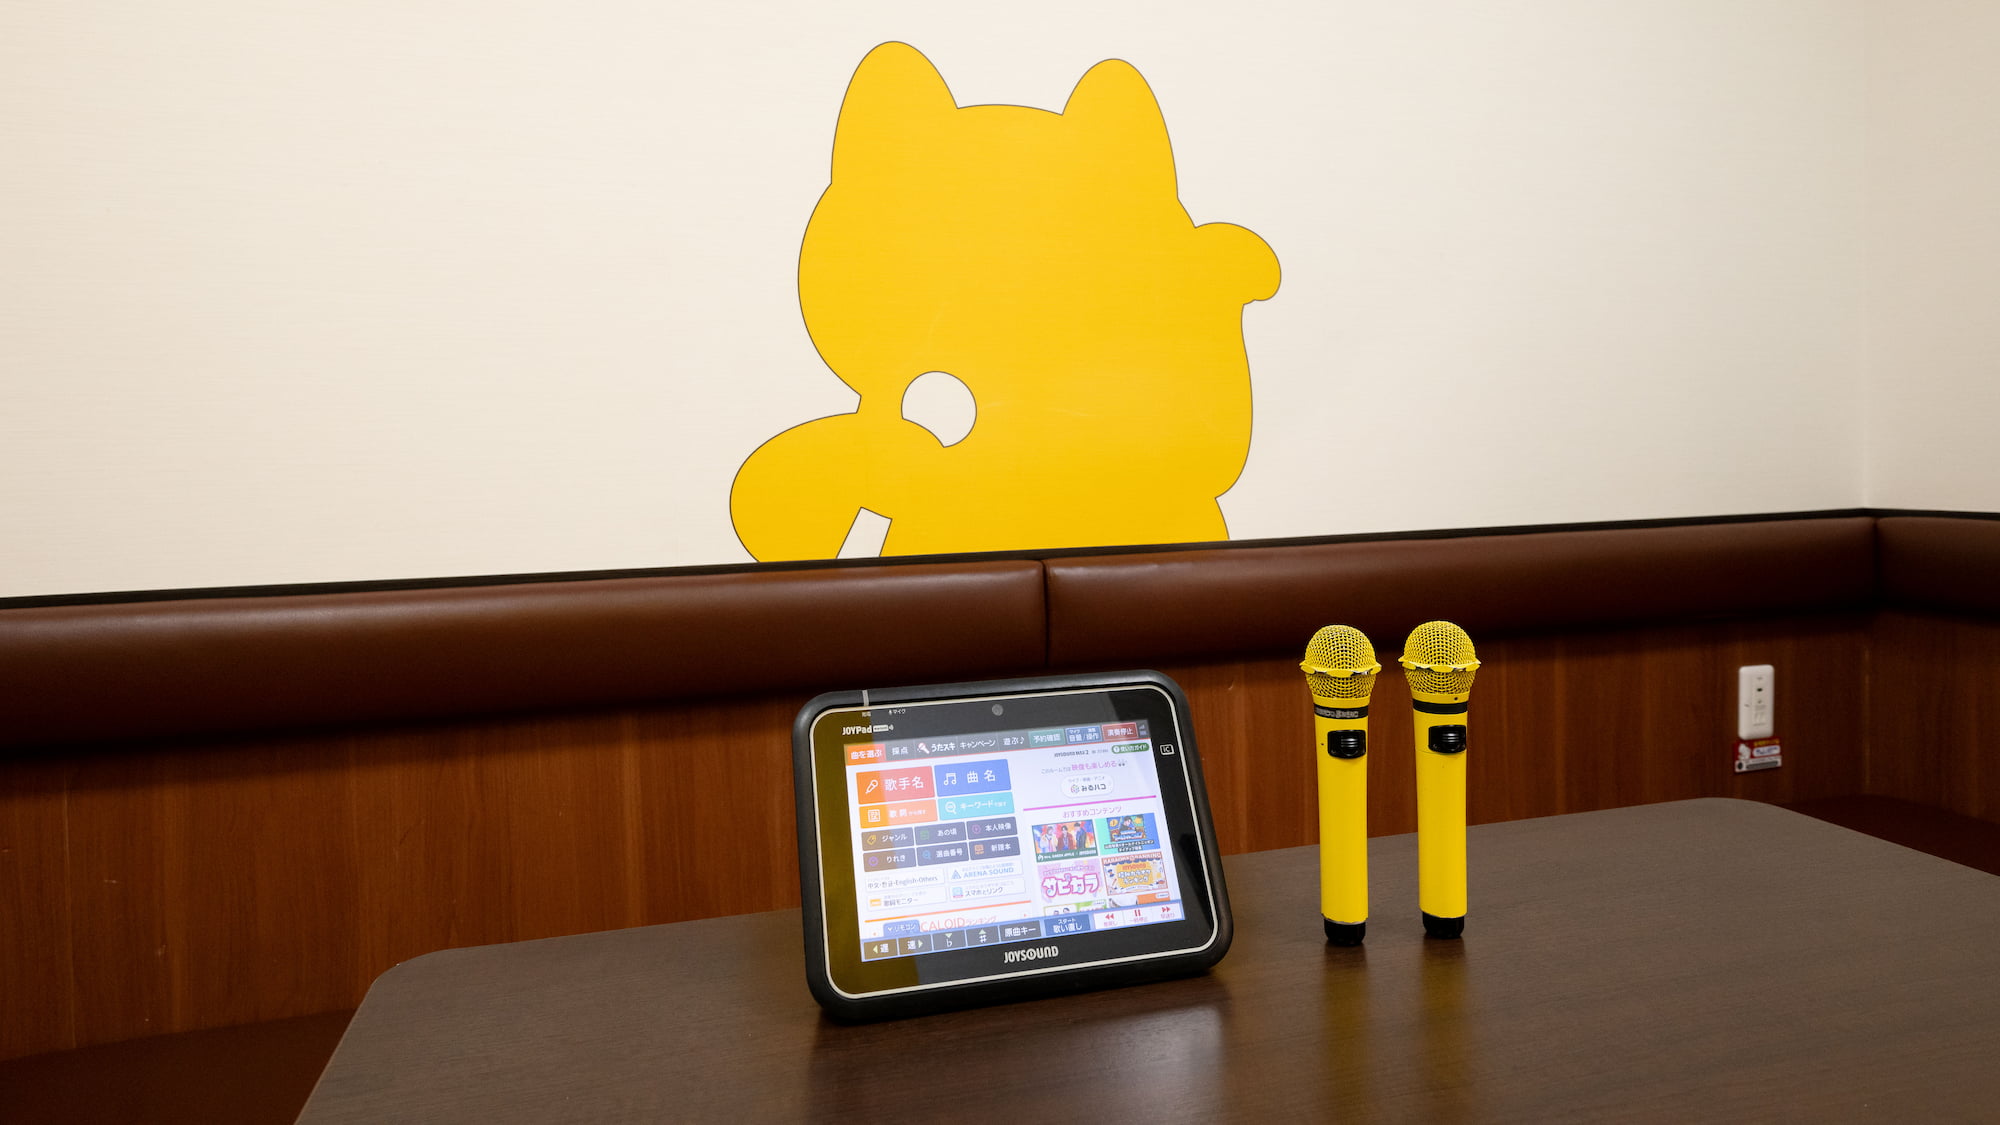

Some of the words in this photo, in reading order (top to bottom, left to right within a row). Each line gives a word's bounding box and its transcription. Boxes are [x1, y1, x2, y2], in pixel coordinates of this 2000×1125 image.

[842, 725, 872, 735] JOYPad
[1107, 728, 1134, 737] 演奏停止
[1033, 733, 1061, 743] 予約確認
[931, 742, 956, 753] うたスキ
[959, 739, 996, 749] キャンペーン
[850, 749, 882, 760] 曲を選ぶ
[892, 746, 908, 756] 採点
[884, 776, 924, 792] 歌手名
[1081, 783, 1107, 792] みるハコ
[1062, 806, 1122, 819] おすすめコンテンツ
[937, 828, 957, 837] あの頃
[985, 823, 1012, 832] 本人映像
[881, 833, 908, 843] ジャンル
[935, 848, 963, 858] 選曲番号
[886, 854, 906, 863] りれき
[963, 870, 988, 878] ARENA
[988, 866, 1014, 875] SOUND
[1042, 872, 1100, 898] サビカラ
[965, 887, 1003, 897] スマホとリンク
[894, 923, 916, 932] リモコン
[1004, 926, 1037, 938] 原曲キー
[1053, 924, 1083, 934] 歌い直し
[879, 943, 889, 953] 遅
[907, 940, 916, 950] 速
[1004, 946, 1059, 963] JOYSOUND
